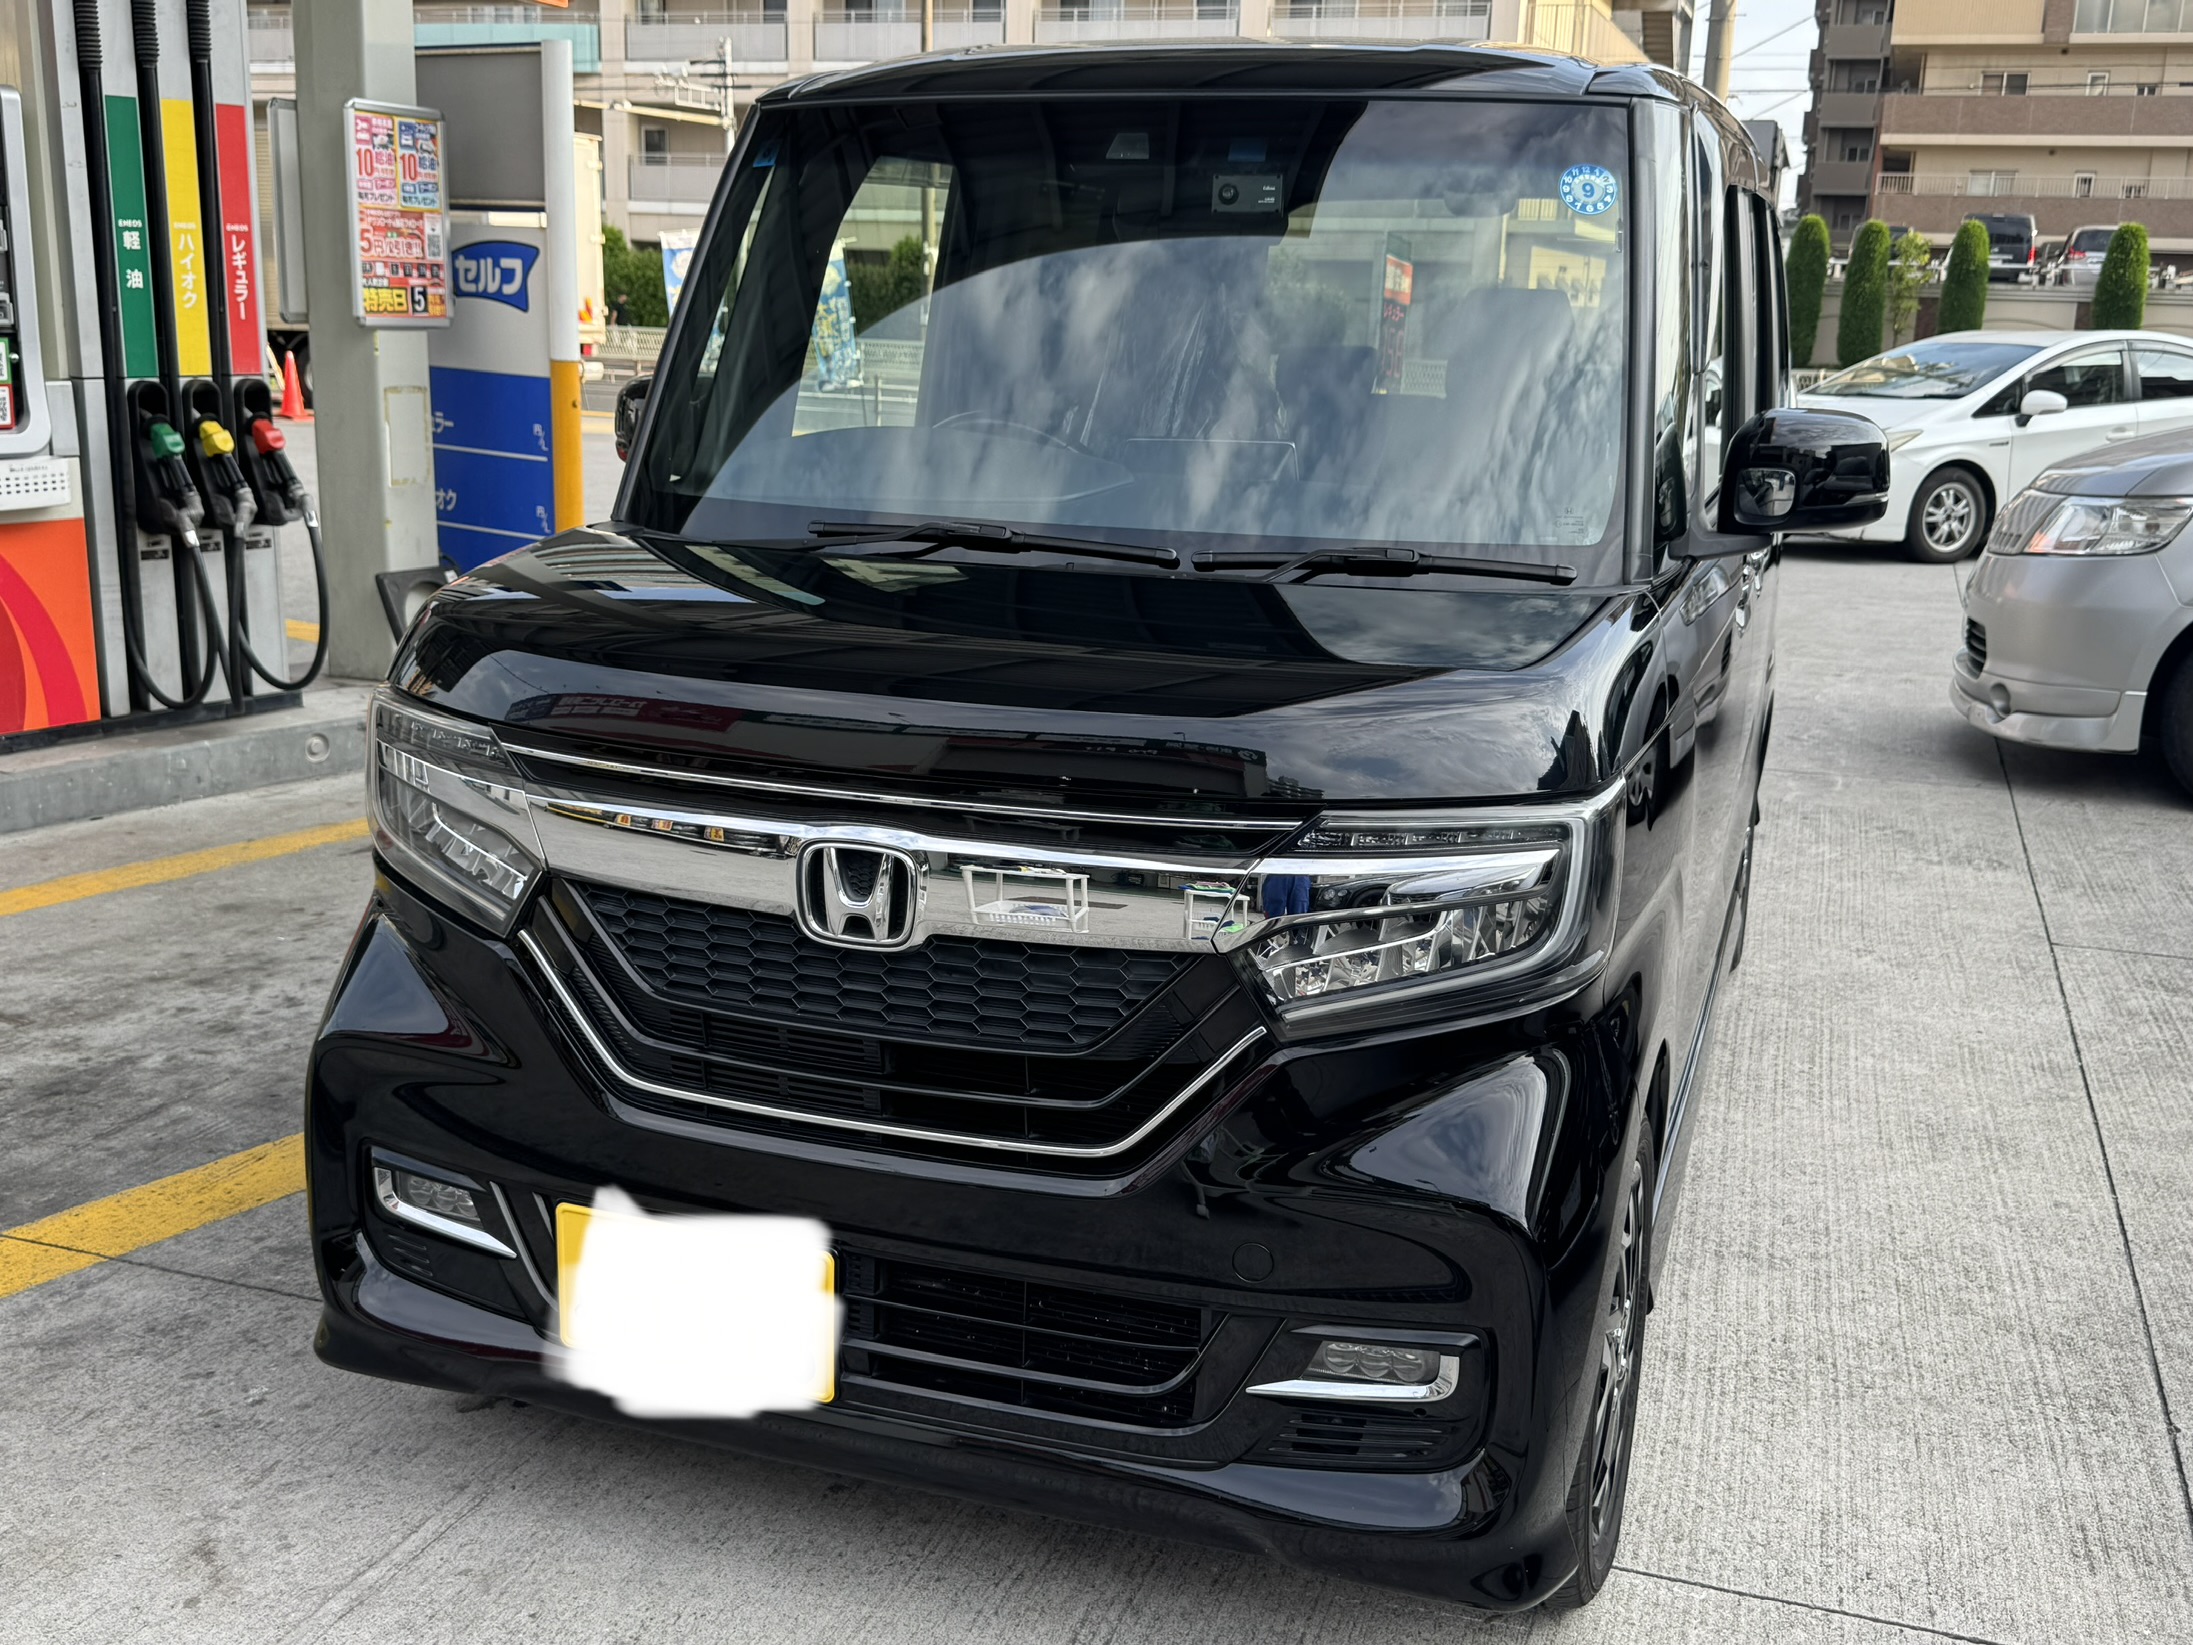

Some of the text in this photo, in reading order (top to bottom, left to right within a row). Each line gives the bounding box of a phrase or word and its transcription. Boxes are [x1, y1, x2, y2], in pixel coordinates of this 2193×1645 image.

[356, 147, 374, 177] 10
[400, 153, 417, 181] 10
[1564, 175, 1572, 184] 10
[1572, 168, 1579, 176] 11
[1594, 168, 1600, 176] 1
[1562, 184, 1570, 192] 9
[1582, 182, 1595, 199] 9
[1606, 184, 1614, 193] 3
[1566, 194, 1574, 202] 8
[1596, 202, 1604, 210] 5
[122, 230, 144, 289] 軽油
[178, 233, 198, 309] ハイオク
[231, 234, 249, 320] レギュラー
[455, 254, 523, 296] セルフ
[413, 286, 426, 311] 5
[432, 411, 454, 433] ラー
